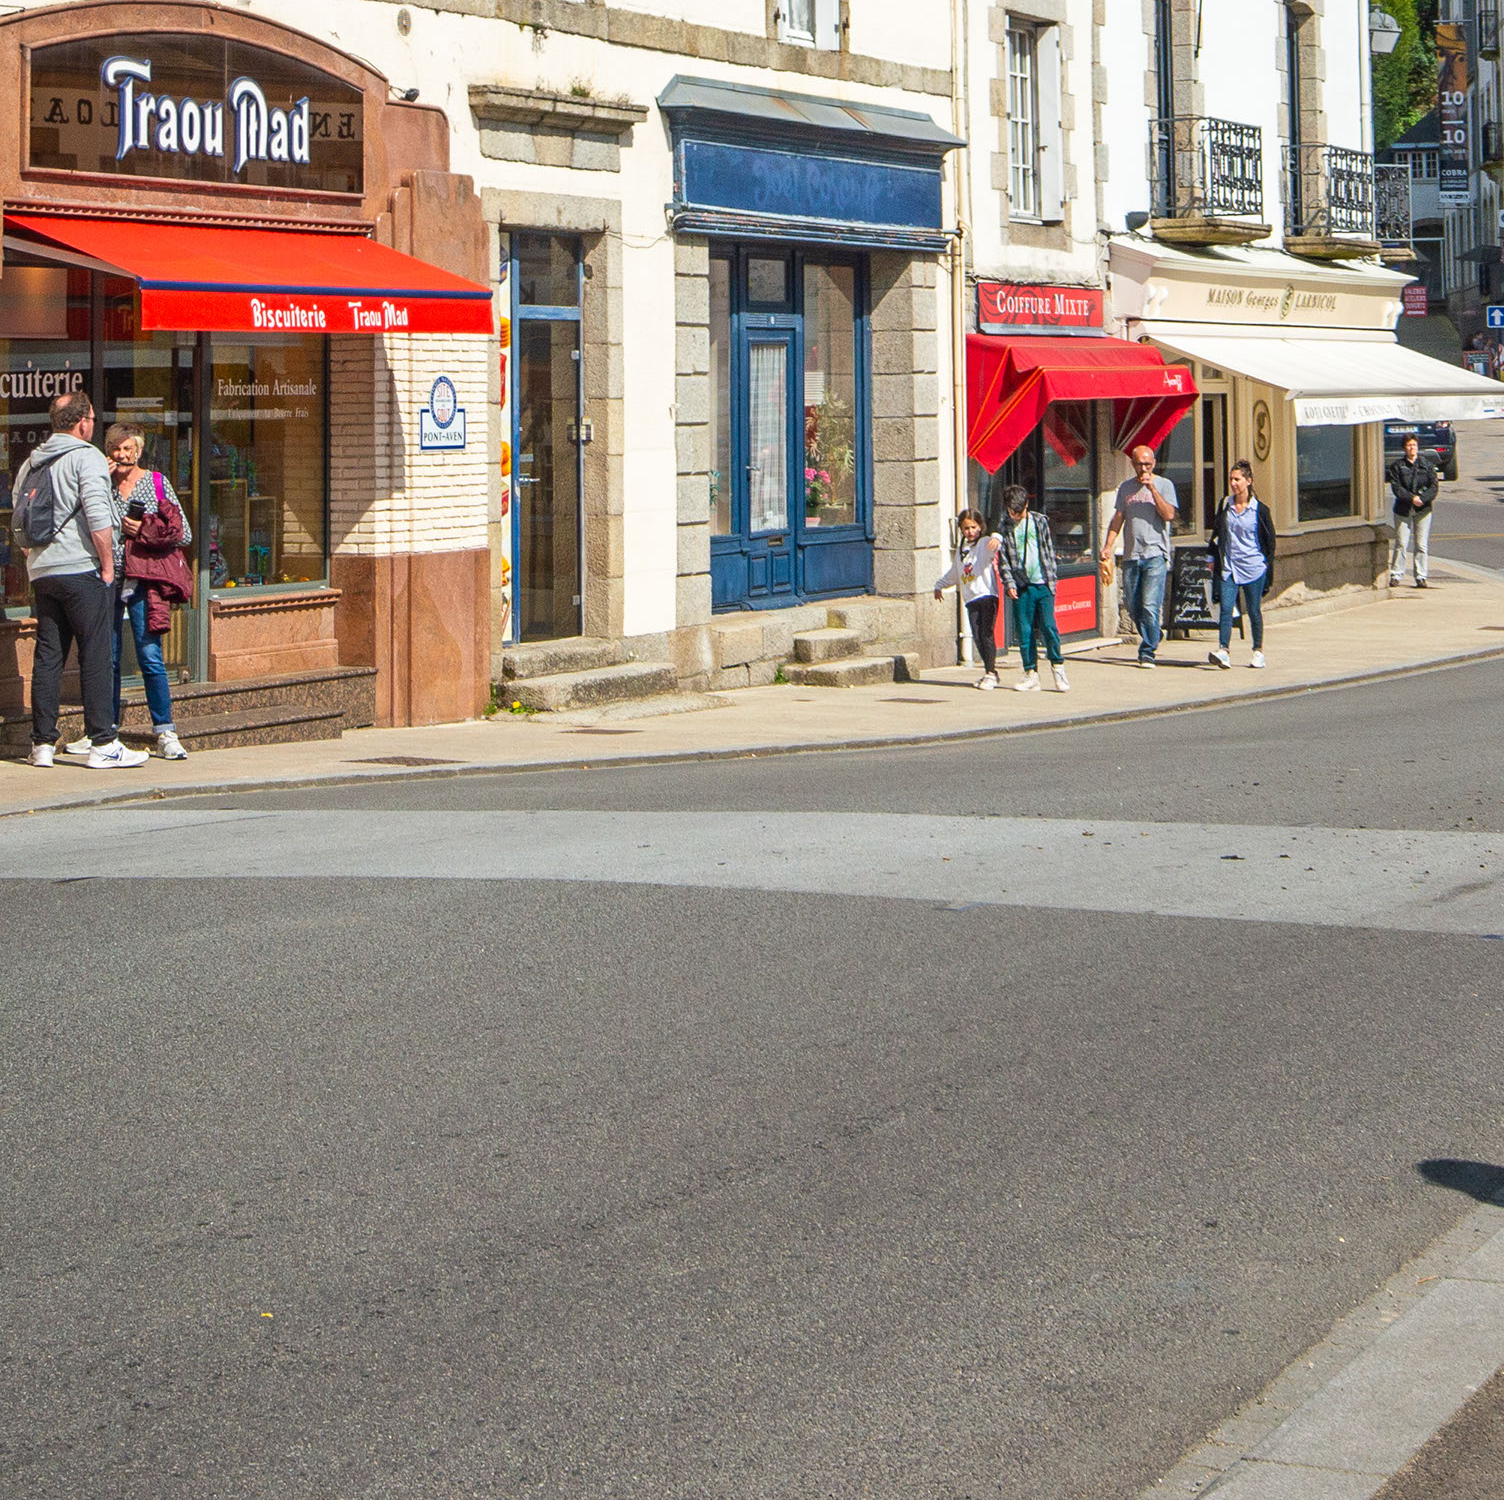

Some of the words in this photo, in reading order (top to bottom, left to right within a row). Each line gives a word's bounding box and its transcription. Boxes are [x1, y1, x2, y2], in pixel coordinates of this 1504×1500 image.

[1441, 90, 1464, 106] 10
[100, 55, 224, 161] Traou
[228, 76, 311, 174] Mad
[1443, 129, 1466, 144] 10
[997, 290, 1051, 315] COIFFURE
[1054, 293, 1090, 316] MIXTE
[1207, 288, 1244, 305] MAISON
[1246, 290, 1279, 312] Georges
[1295, 293, 1337, 311] LARNICOL
[251, 298, 326, 328] Biscuiterie
[348, 301, 382, 330] Traou
[382, 301, 409, 329] Mad
[217, 379, 269, 396] Fabrication
[272, 379, 317, 396] Artisanale
[424, 432, 463, 442] PONT-AVEN
